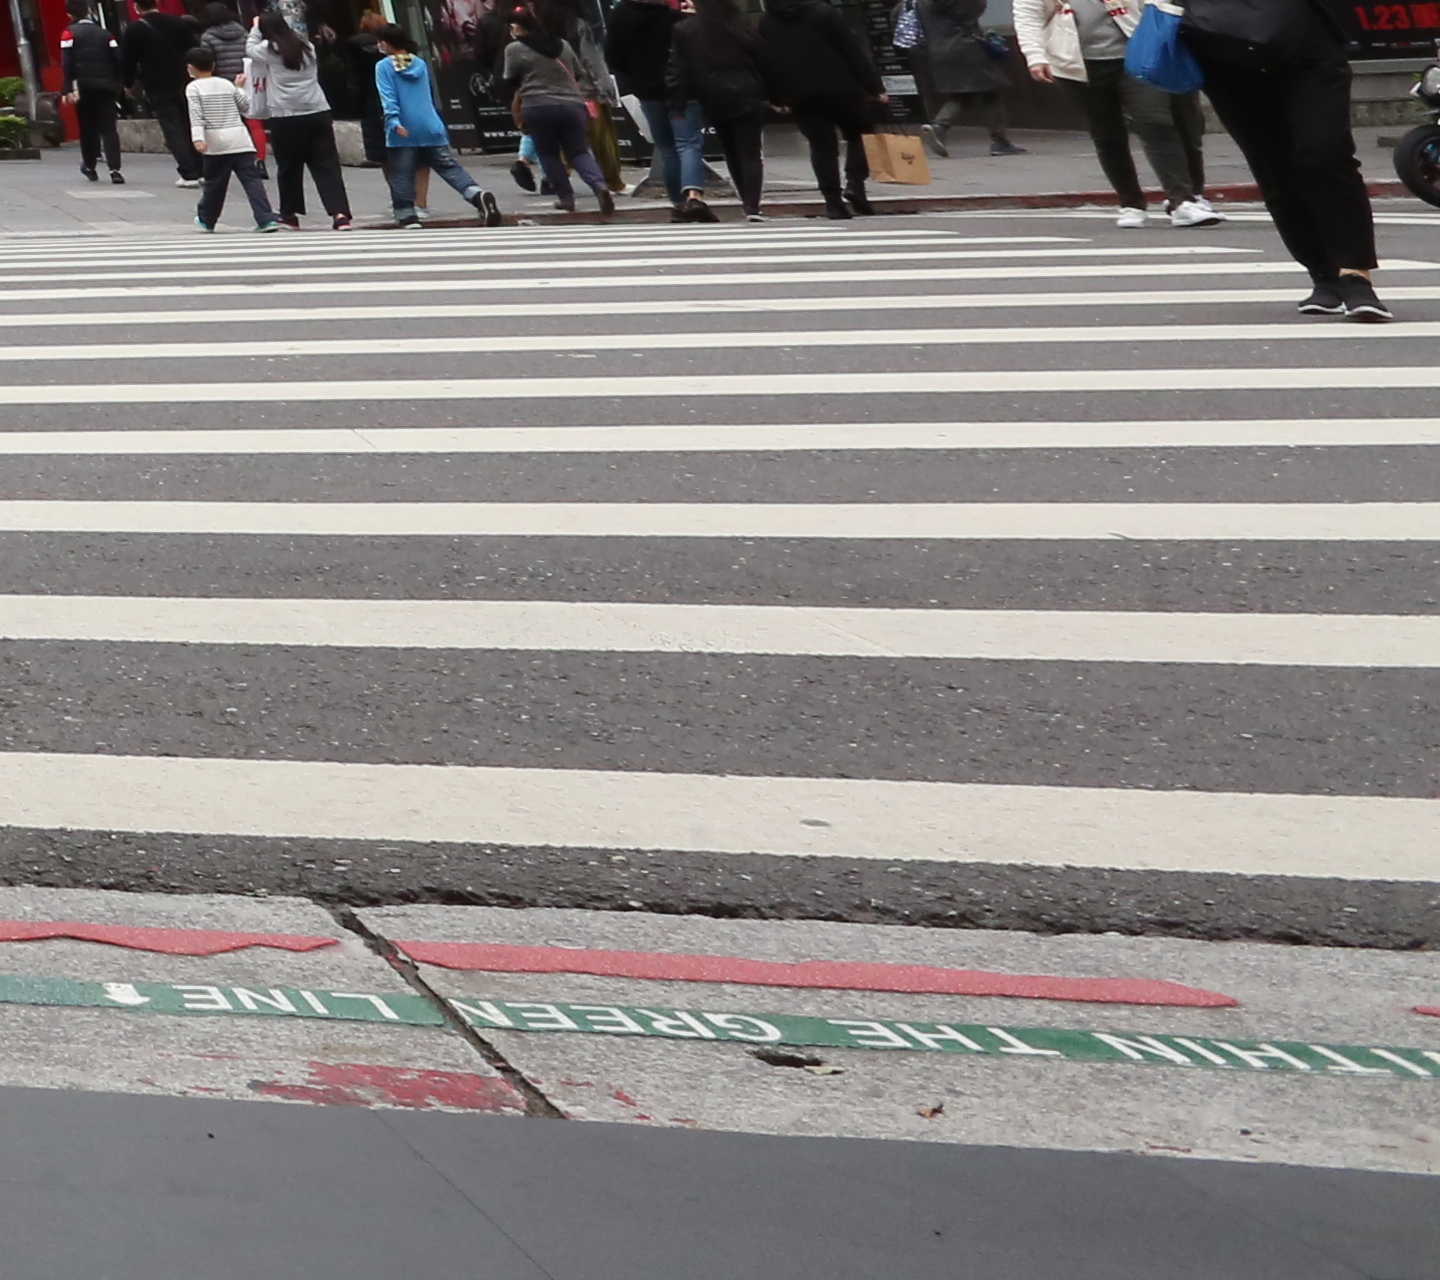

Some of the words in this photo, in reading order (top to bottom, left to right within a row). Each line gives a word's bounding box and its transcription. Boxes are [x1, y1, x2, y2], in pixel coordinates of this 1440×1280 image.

[182, 984, 402, 1021] LINE
[448, 997, 784, 1044] GREEN
[827, 1018, 1061, 1058] THE
[1091, 1031, 1440, 1078] ITHIN
